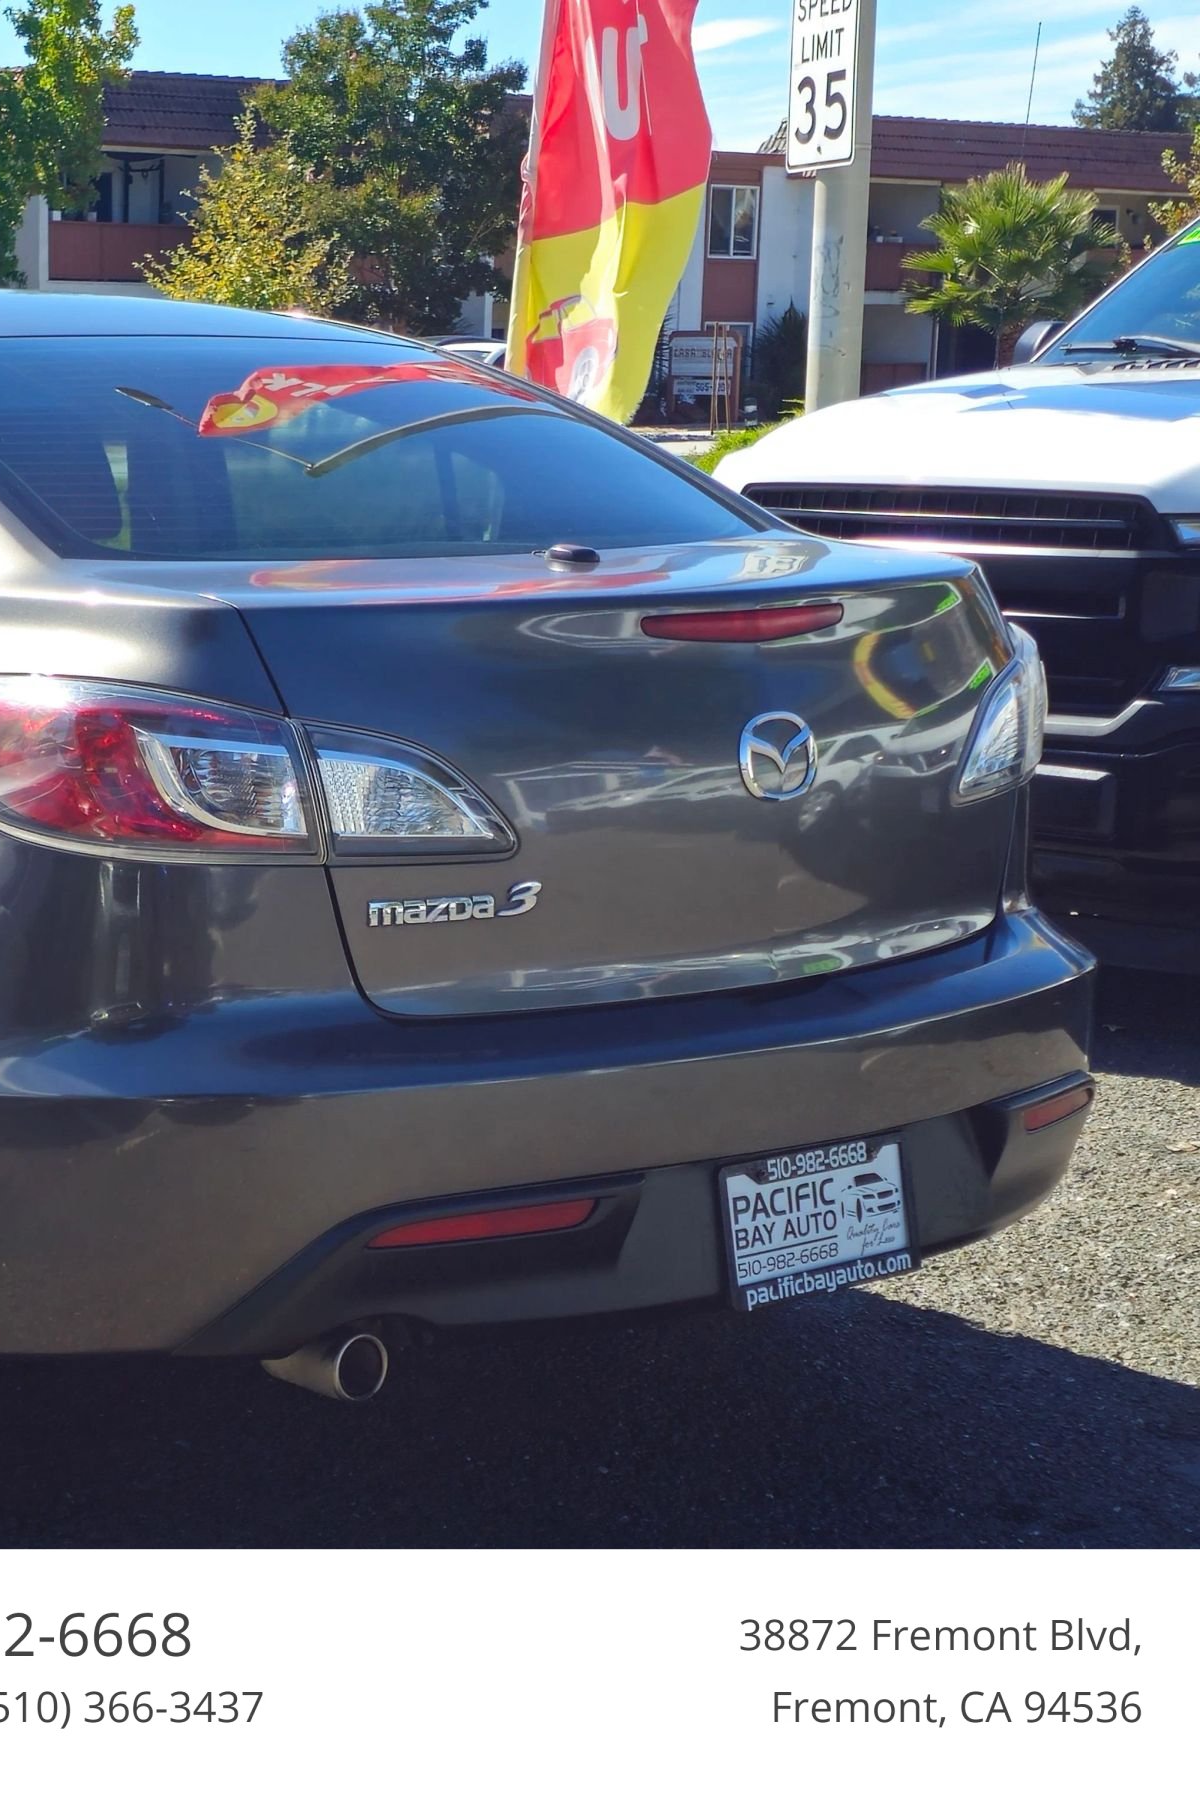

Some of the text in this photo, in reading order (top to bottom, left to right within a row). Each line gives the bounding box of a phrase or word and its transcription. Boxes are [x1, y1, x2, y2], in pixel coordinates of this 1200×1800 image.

[801, 28, 844, 63] LIMIT
[795, 69, 847, 145] 35
[497, 881, 542, 917] 3
[767, 1141, 867, 1181] 510-982-6668
[732, 1178, 836, 1225] PACIFIC
[735, 1210, 838, 1251] BAY AUTO
[738, 1243, 839, 1279] 510-982-6668
[746, 1253, 912, 1311] pacificbayauto.com
